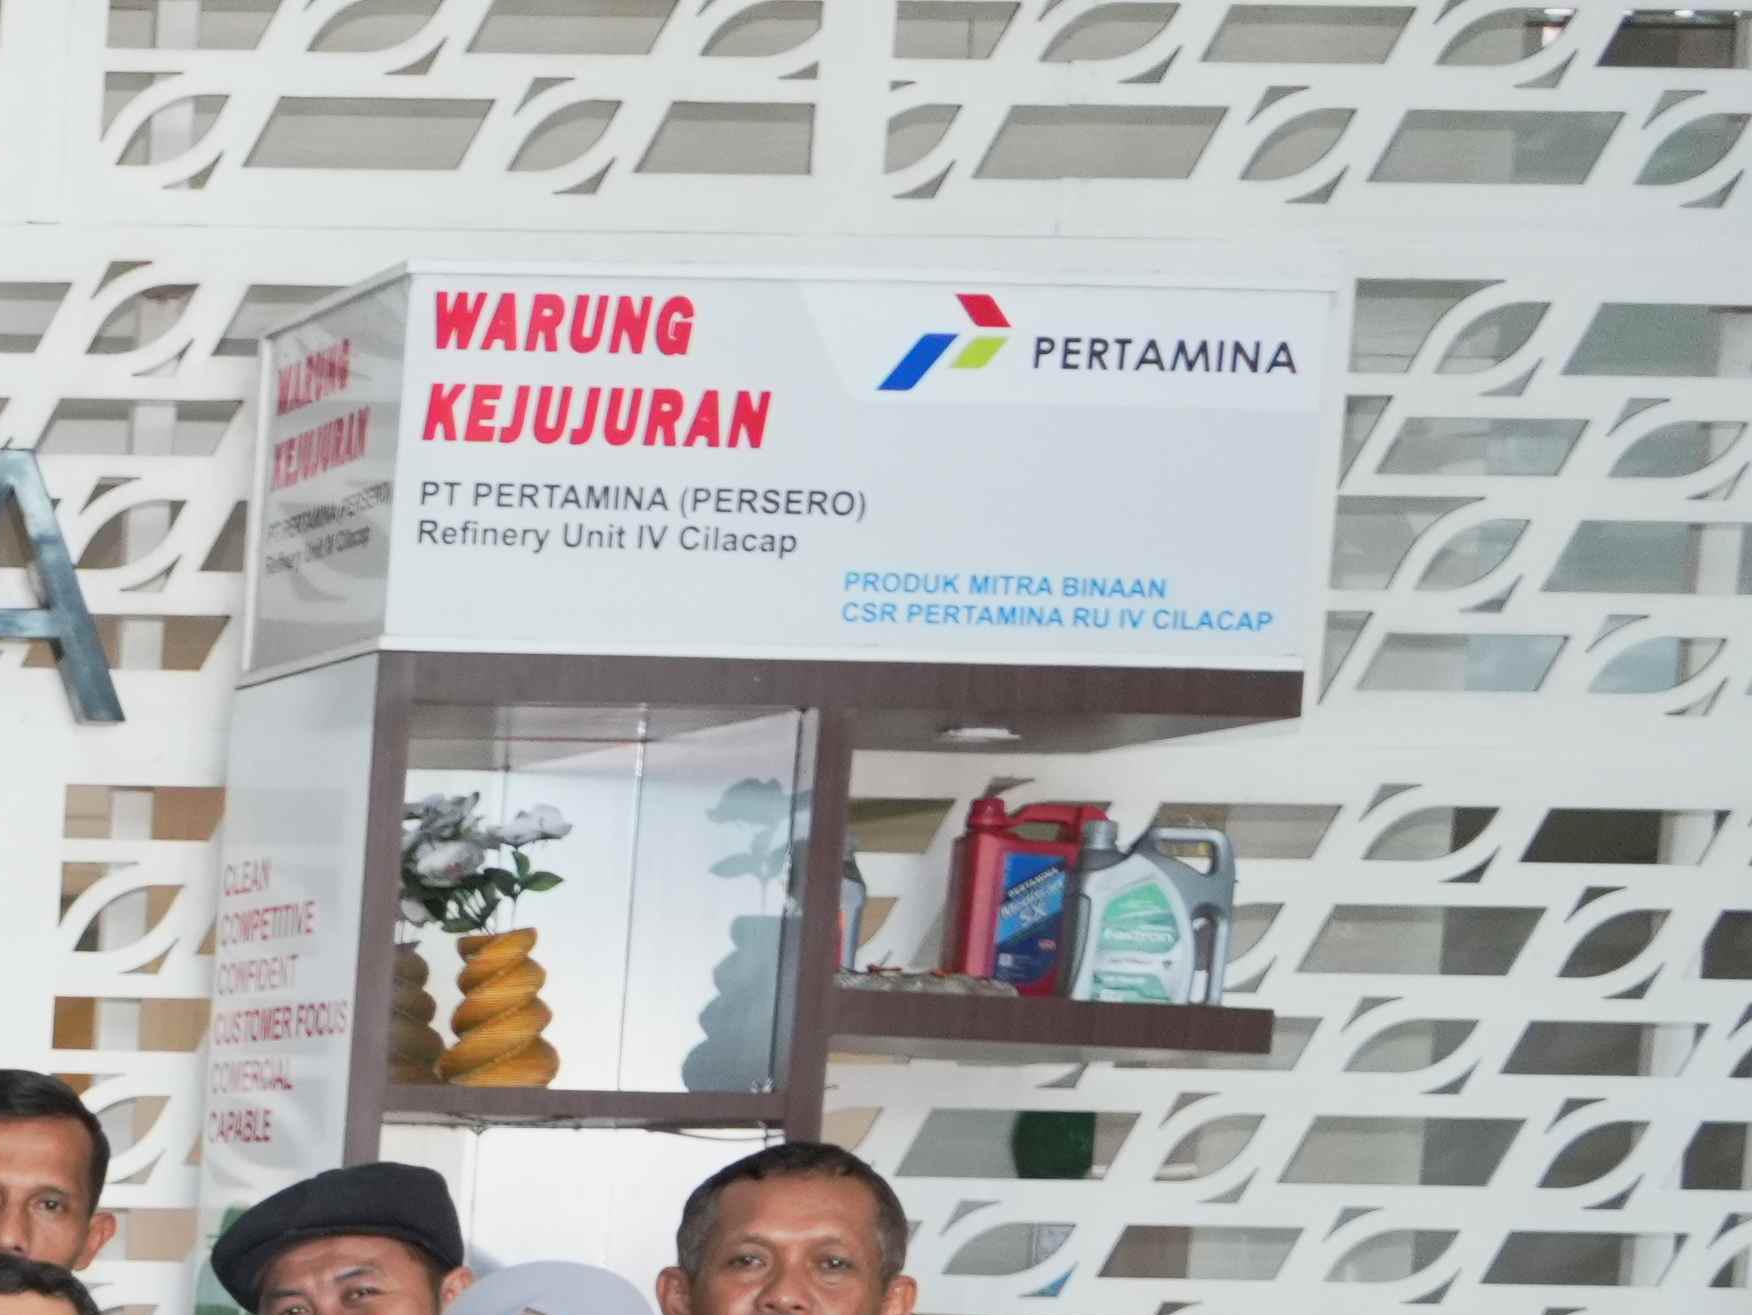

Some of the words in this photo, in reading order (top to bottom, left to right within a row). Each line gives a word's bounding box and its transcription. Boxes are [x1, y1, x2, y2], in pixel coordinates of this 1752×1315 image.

[435, 291, 695, 356] WARUNG
[1033, 336, 1297, 375] PERTAMINA
[422, 383, 772, 448] KEJUJURAN
[421, 481, 461, 508] PT
[473, 483, 668, 512] PERTAMINA
[680, 488, 866, 520] (PERSERO)
[418, 520, 550, 554] Refinery
[563, 522, 625, 550] Unit
[637, 524, 668, 550] IV
[680, 525, 797, 559] Cilacap
[845, 572, 960, 595] PRODUK
[968, 574, 1053, 597] MITRA
[1062, 576, 1167, 598] BINAAN
[842, 602, 897, 624] CSR
[906, 604, 1066, 627] PERTAMINA
[1073, 607, 1110, 628] RU
[1120, 608, 1144, 629] IV
[1152, 609, 1273, 632] CILACAP
[224, 858, 271, 896] CLEAN
[221, 901, 315, 946] COMPETITIVE
[218, 954, 300, 994] CONFIDENT
[215, 1005, 292, 1045] CUSTOMER
[295, 1001, 347, 1038] FOCUS
[208, 1109, 271, 1143] CAPABLE
